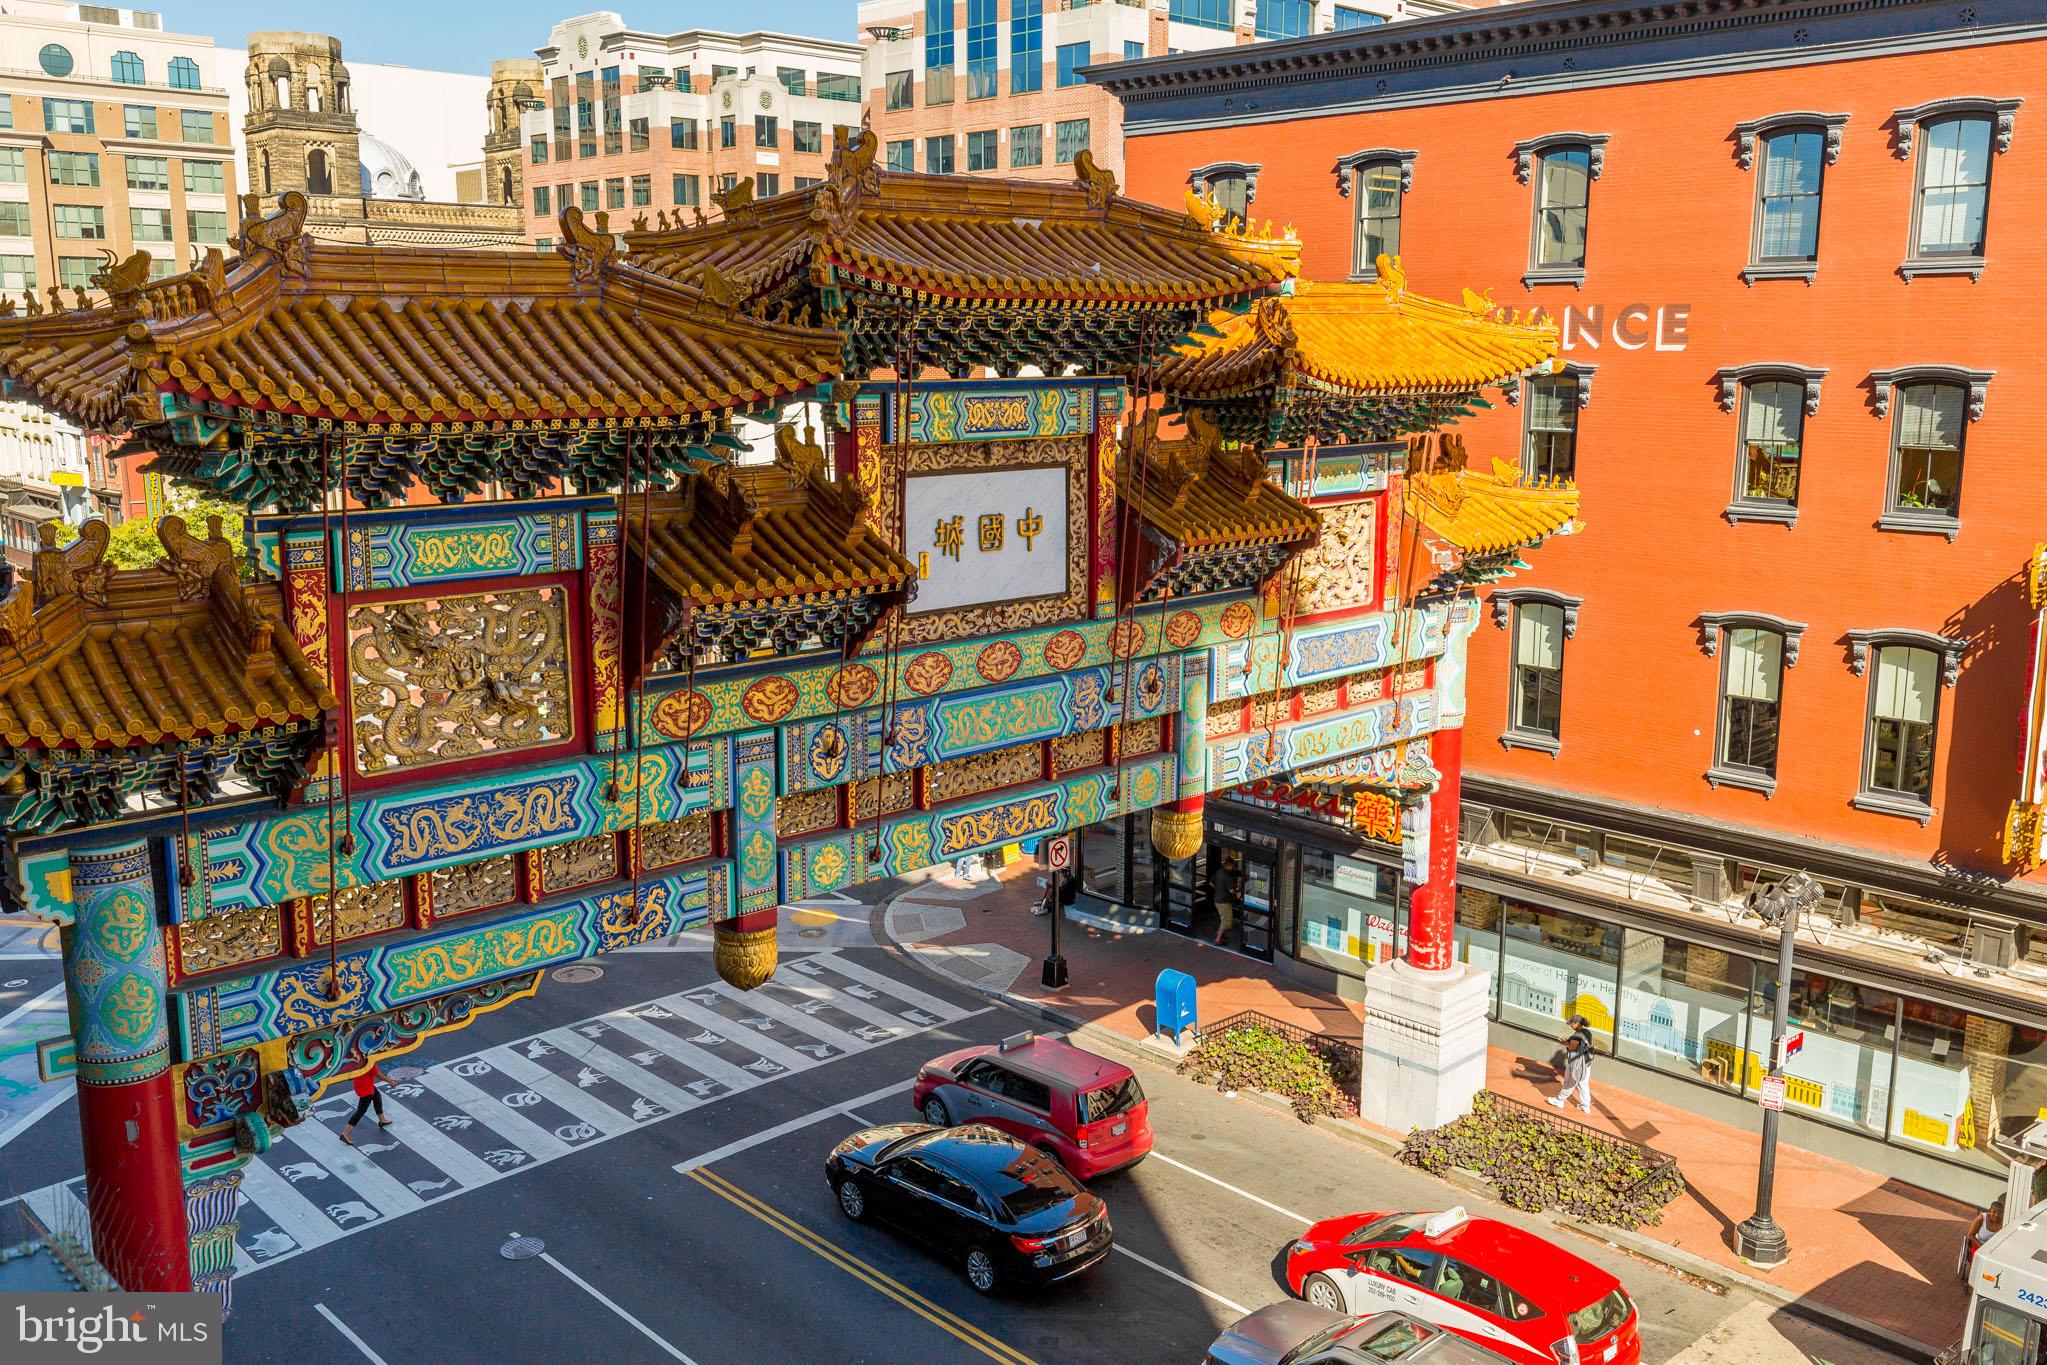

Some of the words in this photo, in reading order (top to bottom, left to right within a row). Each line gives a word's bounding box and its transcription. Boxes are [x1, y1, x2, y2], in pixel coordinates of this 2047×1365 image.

[934, 506, 1044, 563] 中國城
[1354, 791, 1403, 844] 藥
[1510, 960, 1541, 977] corner
[1543, 968, 1554, 977] of
[1556, 970, 1589, 989] Happy
[1368, 1279, 1386, 1290] LUXURY
[1387, 1286, 1396, 1294] CAB
